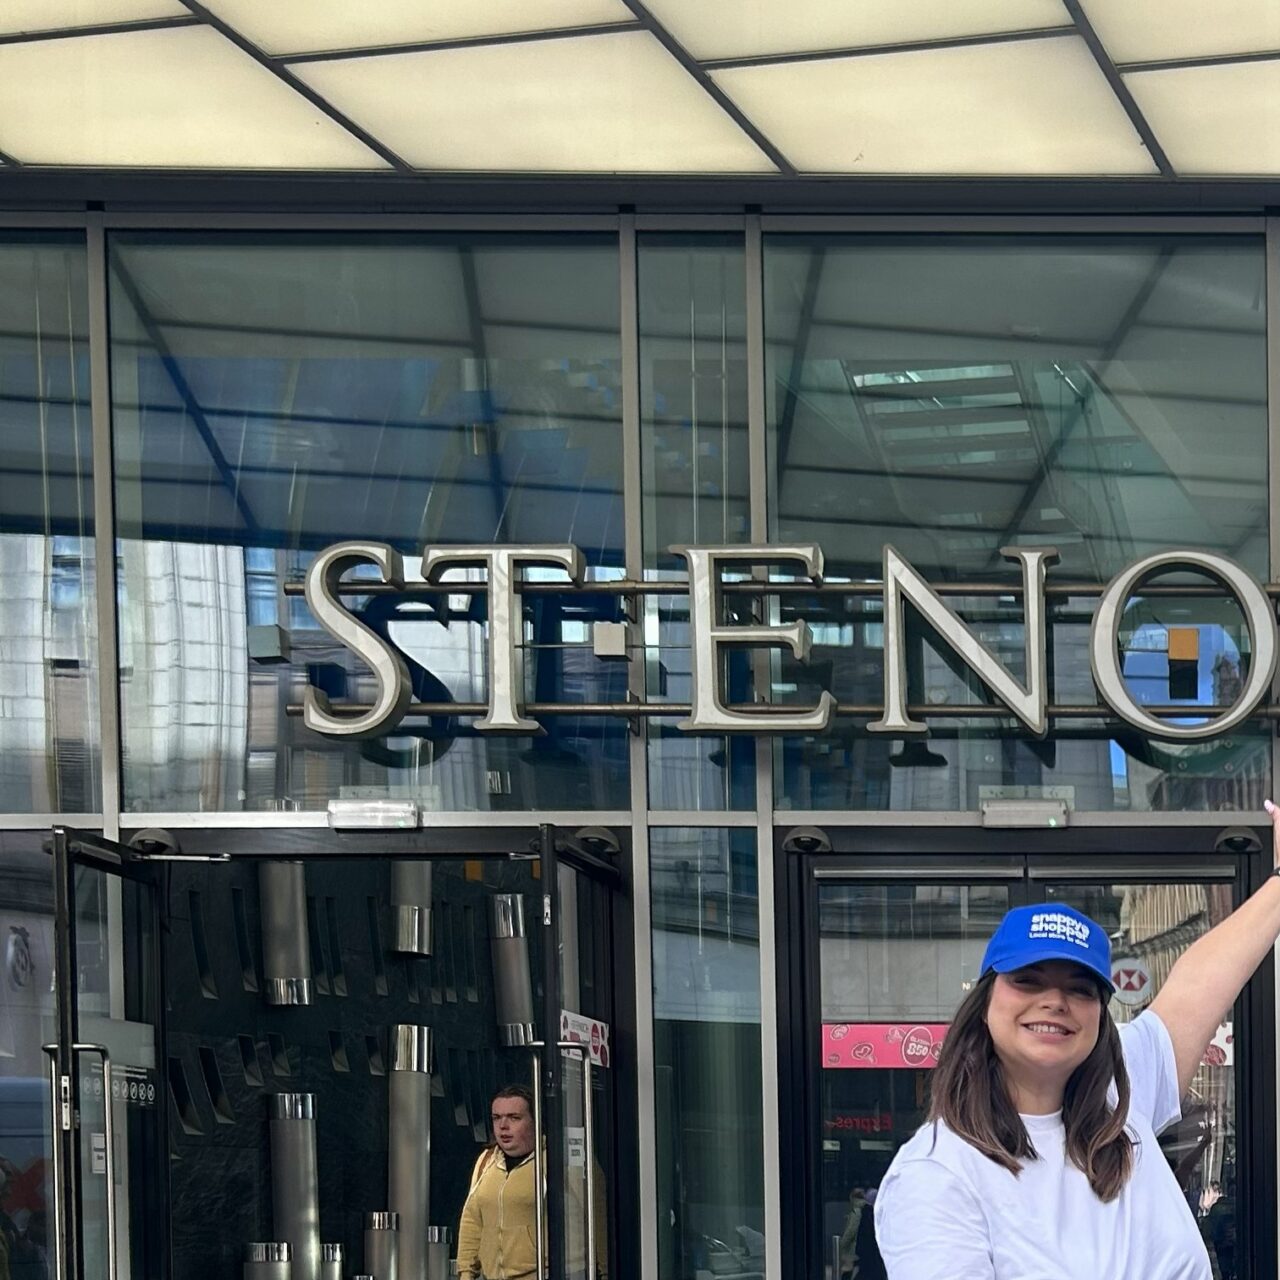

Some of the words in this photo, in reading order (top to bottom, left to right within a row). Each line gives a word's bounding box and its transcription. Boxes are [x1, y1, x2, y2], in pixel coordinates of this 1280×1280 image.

[303, 540, 587, 737] ST
[1030, 921, 1087, 941] shopper
[1031, 913, 1083, 931] snappy
